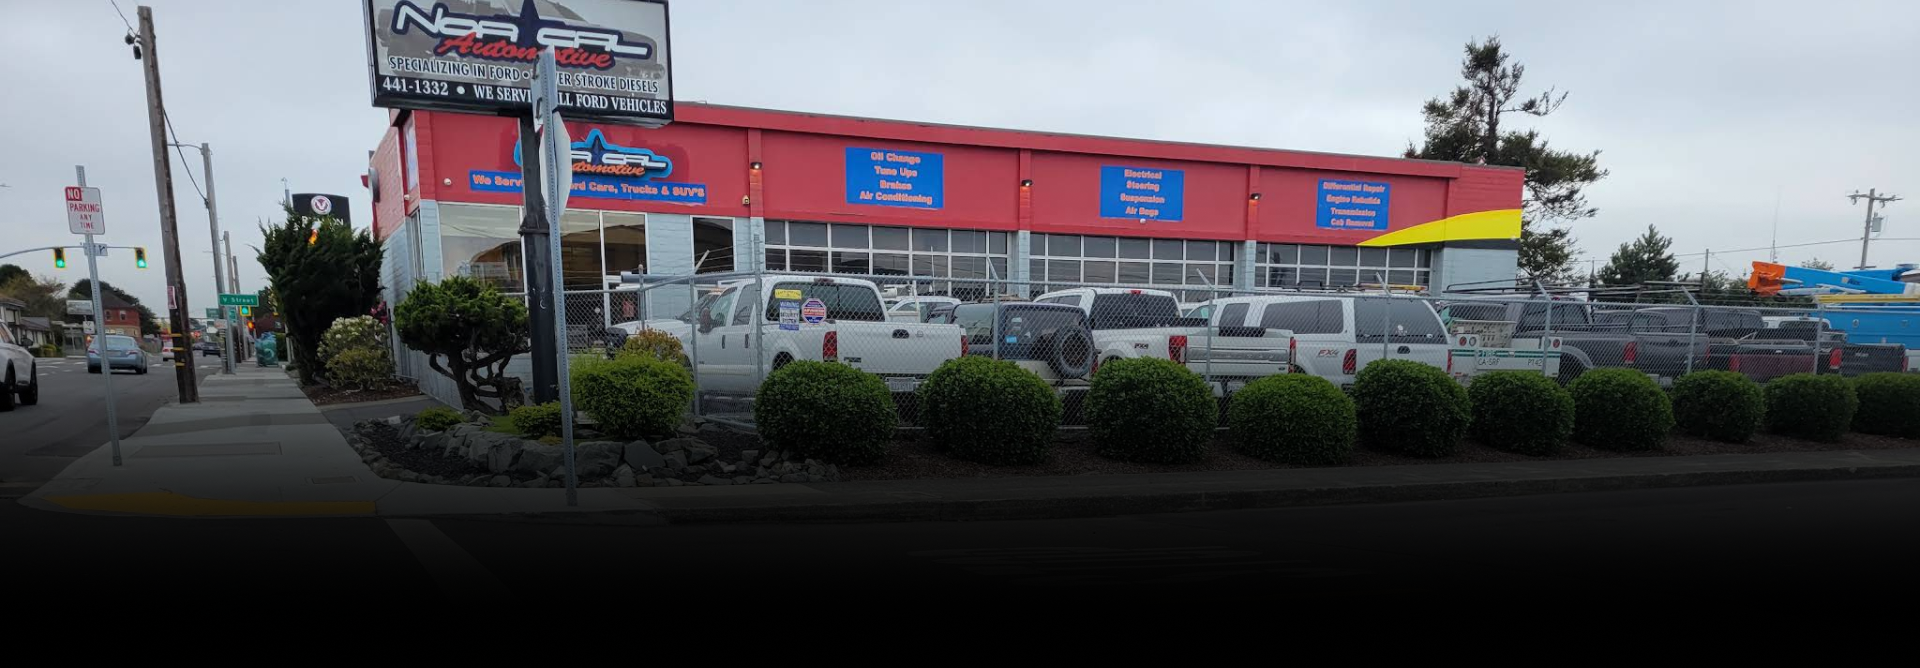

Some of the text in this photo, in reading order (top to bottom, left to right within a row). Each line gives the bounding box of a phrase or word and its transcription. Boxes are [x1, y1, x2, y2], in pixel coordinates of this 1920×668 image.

[436, 31, 612, 69] Automtive
[389, 56, 470, 77] SPECIALIZING
[473, 63, 487, 78] IN
[490, 65, 521, 81] FORD
[382, 76, 449, 96] 441-1332
[575, 73, 616, 90] STROKE
[620, 79, 659, 93] DIESELS
[473, 84, 494, 100] WE
[496, 86, 532, 103] SERVI
[576, 93, 608, 109] FORD
[611, 96, 667, 115] VEHICLES
[870, 151, 921, 164] Oil Change
[874, 165, 918, 178] Tune Ups
[1124, 169, 1162, 179] Electrical
[472, 174, 492, 185] We
[588, 181, 618, 194] Cars,
[620, 183, 658, 195] Trucks
[660, 185, 669, 195] &
[879, 180, 912, 190] Brakes
[1127, 180, 1160, 192] Steering
[1323, 181, 1386, 194] Differential Repair
[67, 188, 80, 200] NO
[859, 191, 932, 205] Air Conditioning
[1120, 193, 1165, 204] Suspension
[1326, 194, 1351, 204] Engine
[69, 202, 100, 213] PARKING
[1125, 206, 1159, 218] Air Bags
[80, 213, 93, 221] ANY
[1330, 218, 1374, 227] Cab Removal
[80, 221, 95, 230] TIME
